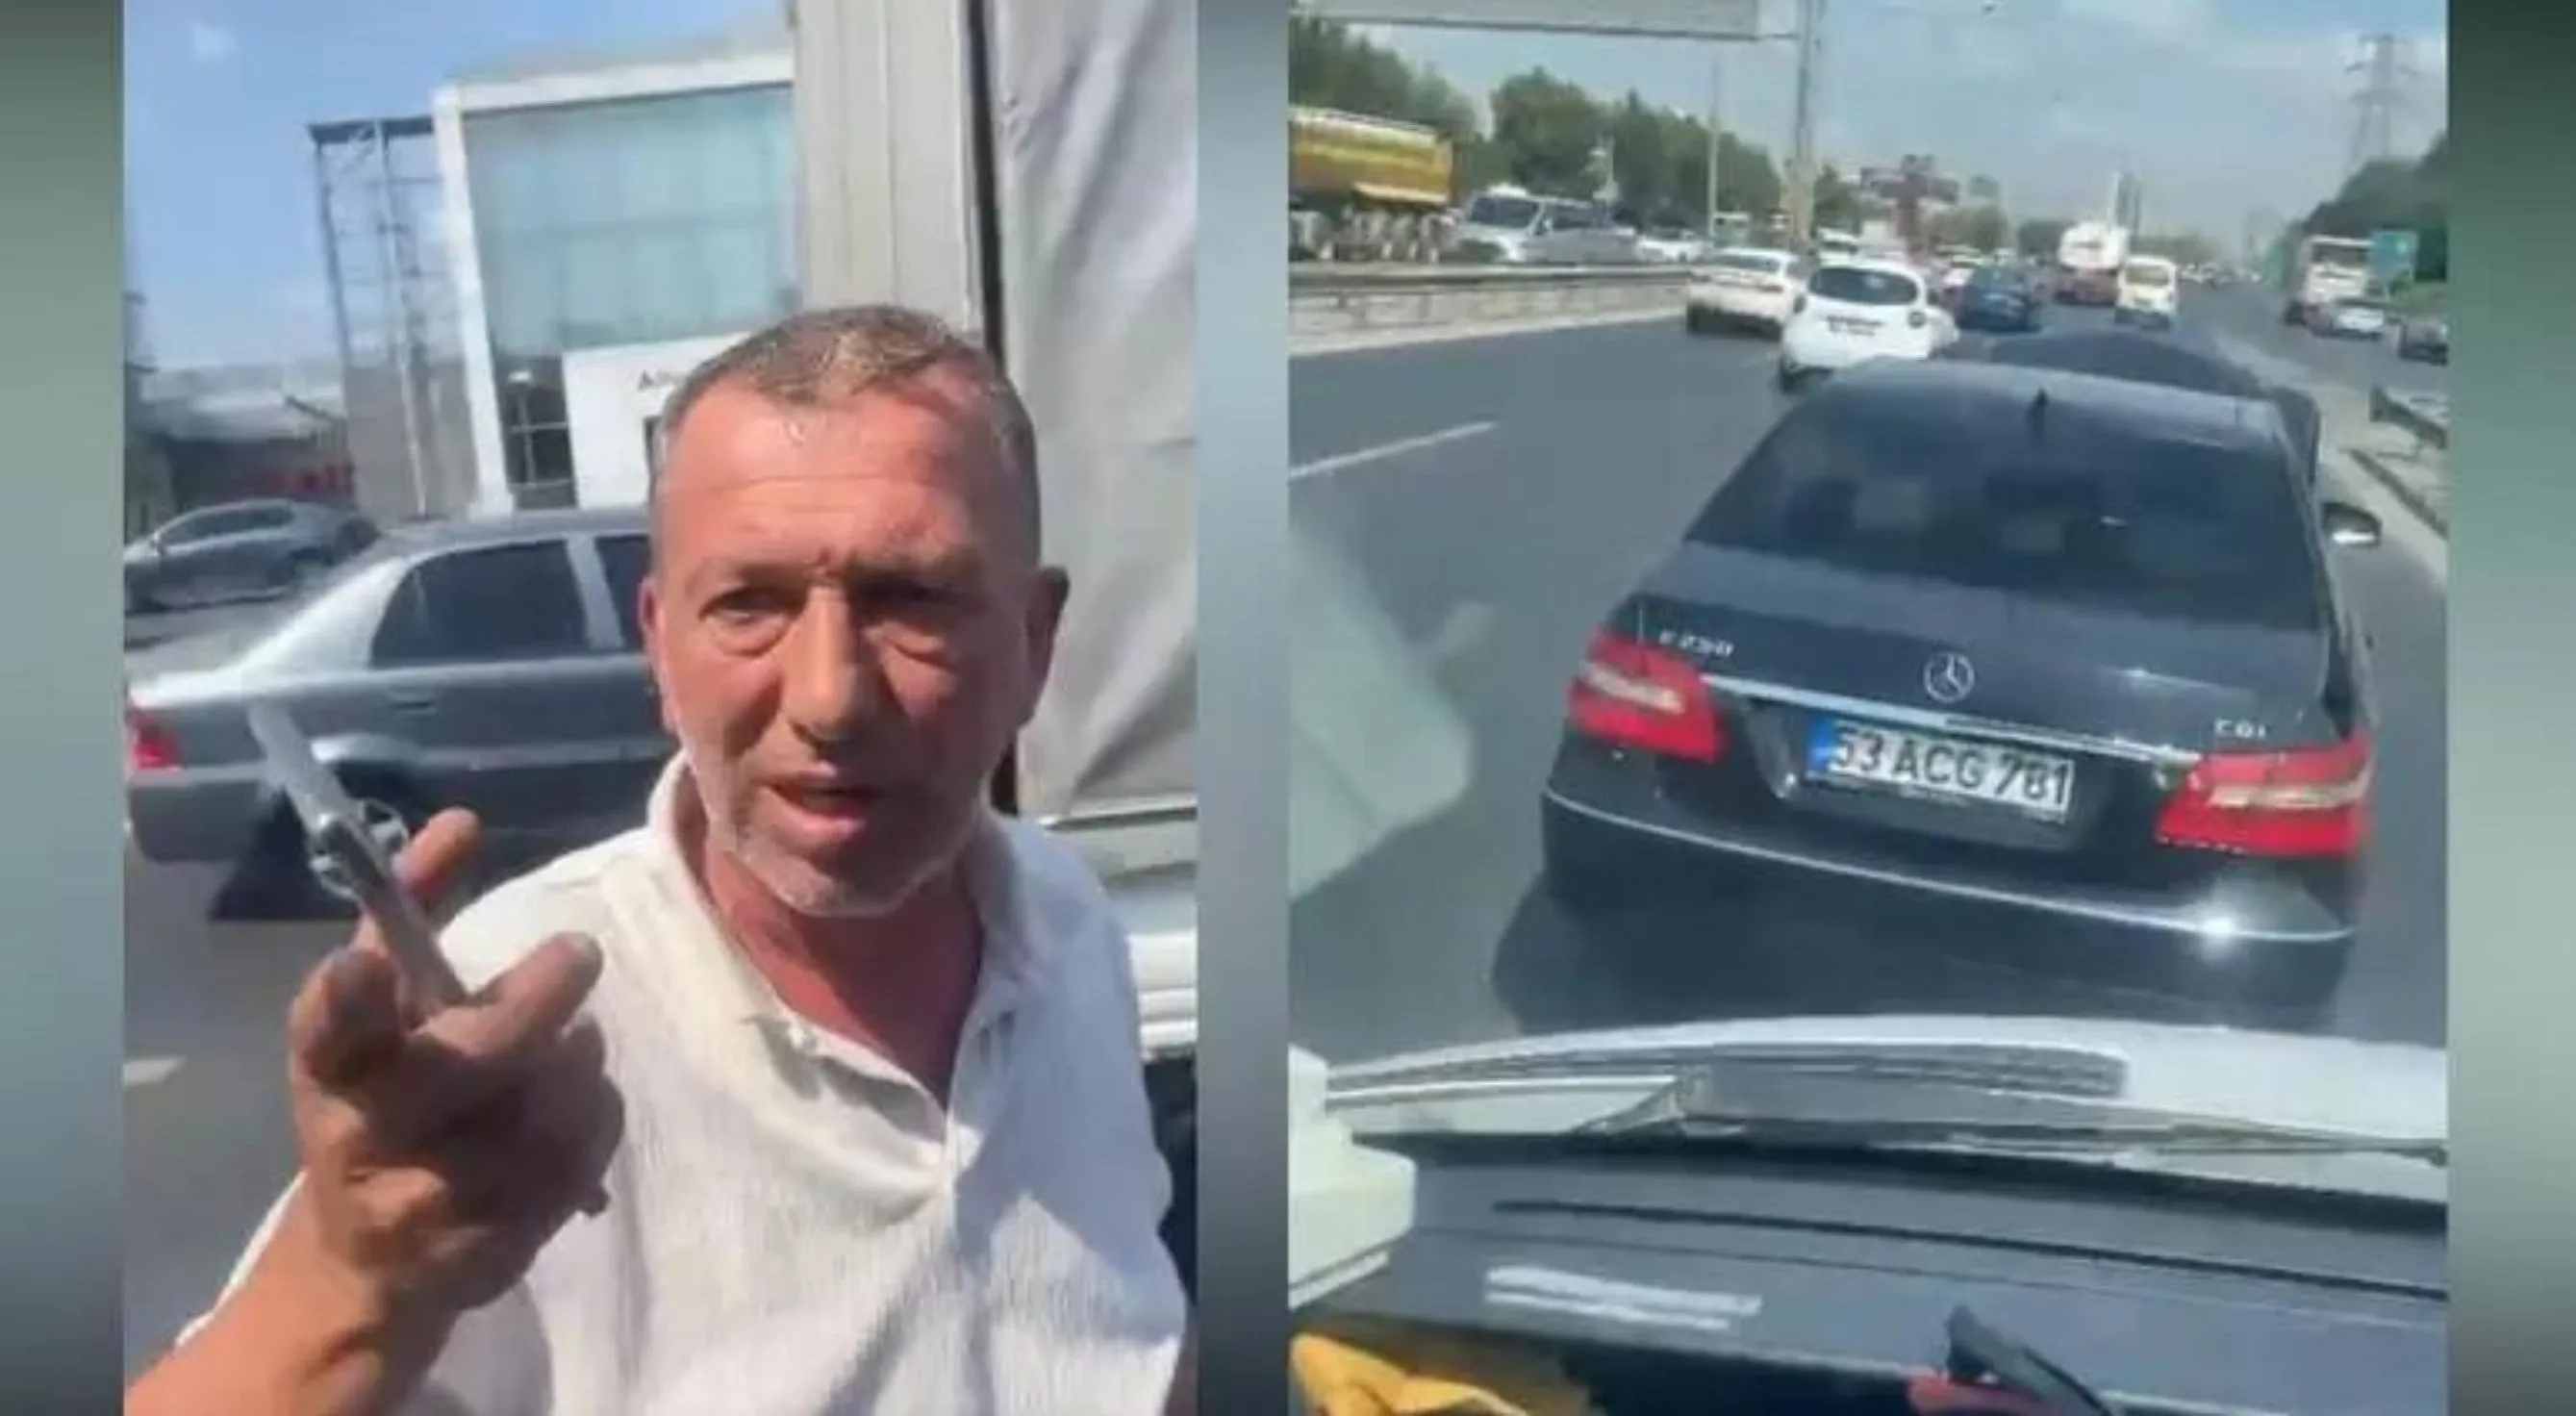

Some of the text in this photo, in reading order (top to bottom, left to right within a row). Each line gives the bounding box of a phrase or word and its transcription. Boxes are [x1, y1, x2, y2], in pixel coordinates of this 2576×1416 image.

[1835, 724, 2068, 805] 53 ACG 781
